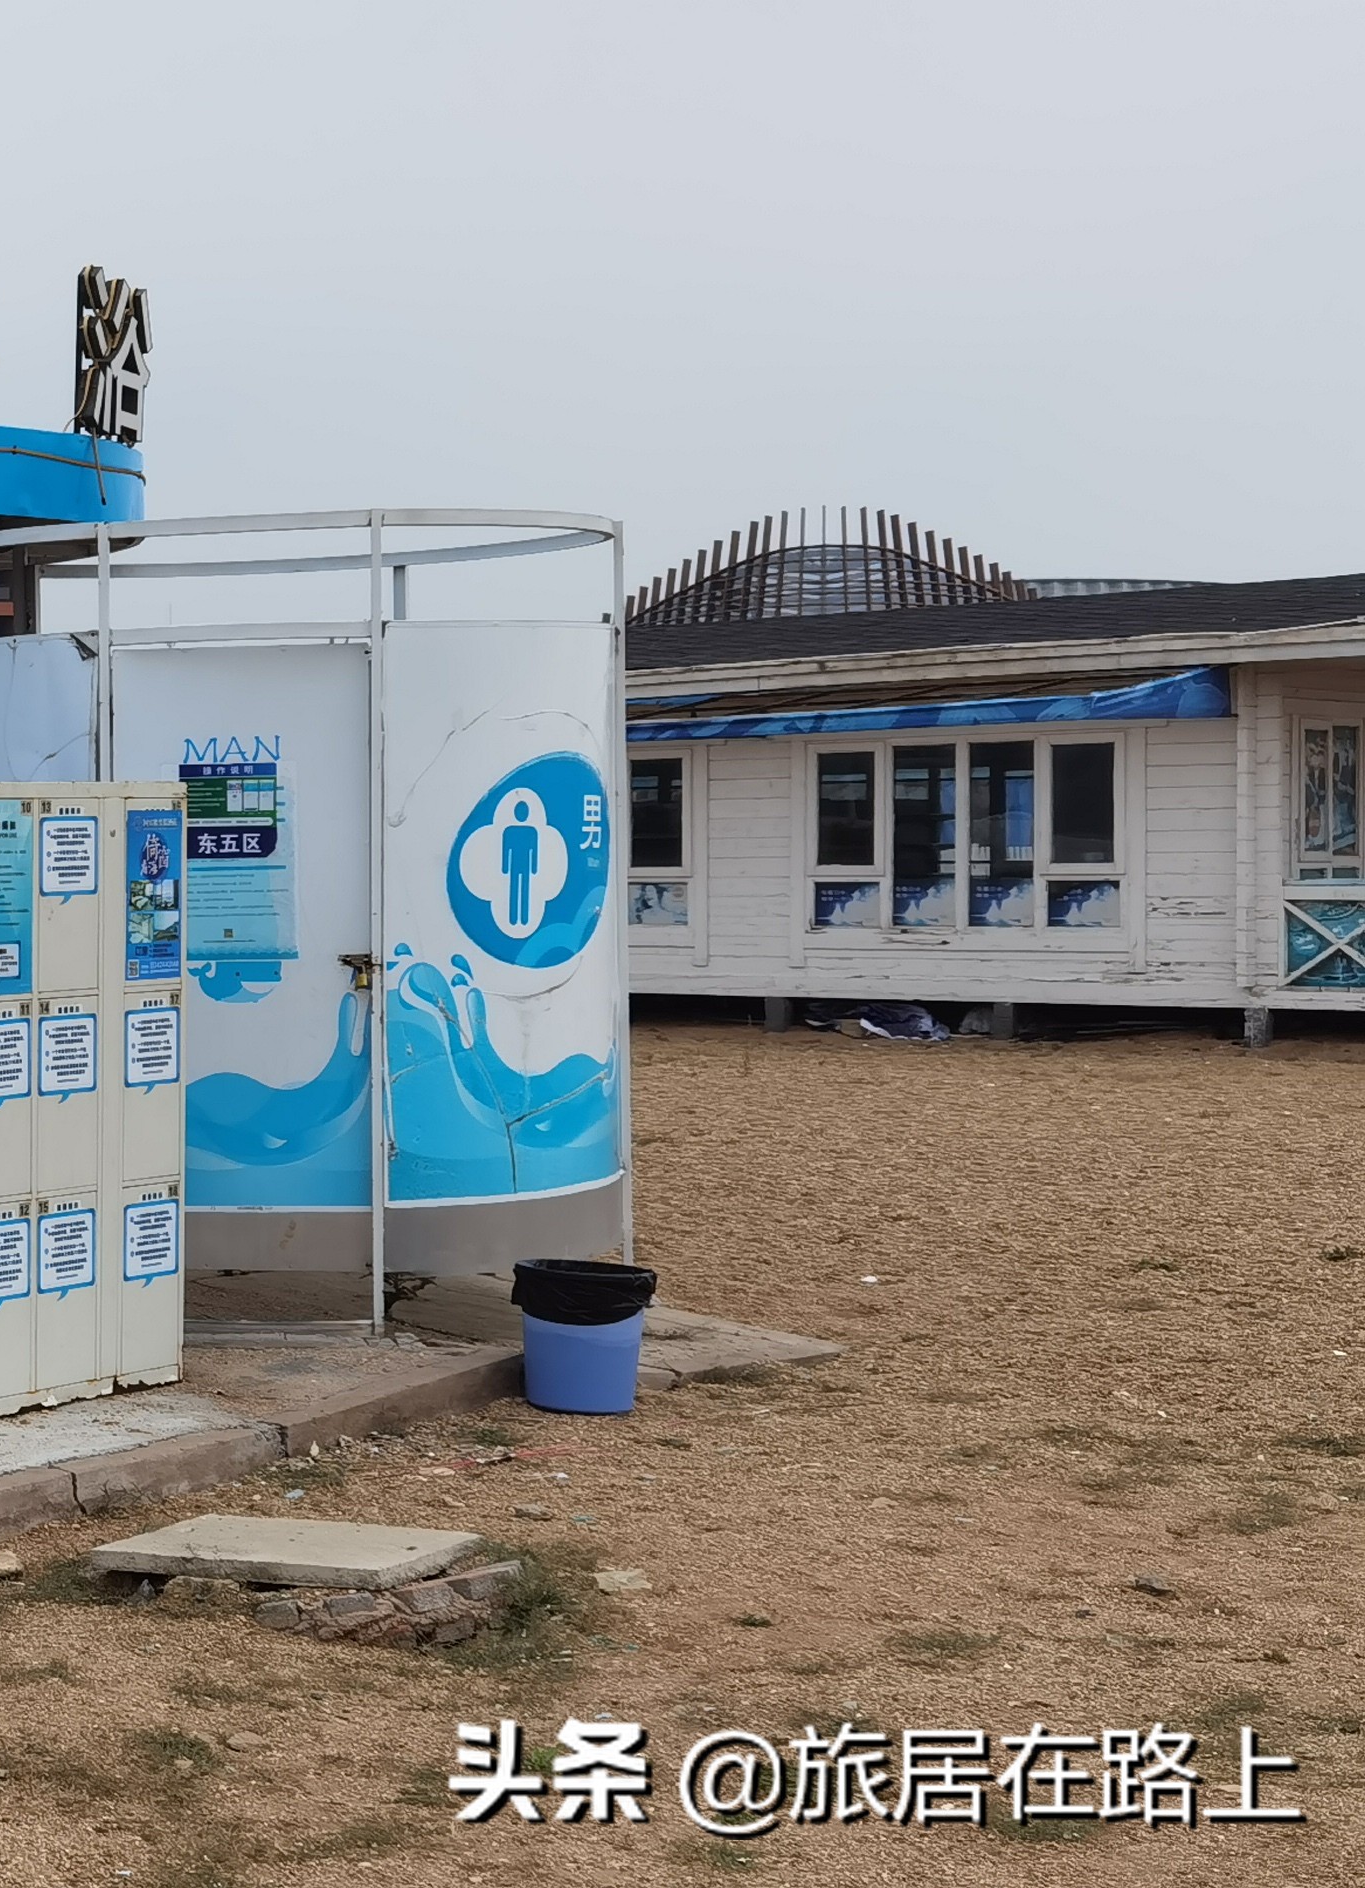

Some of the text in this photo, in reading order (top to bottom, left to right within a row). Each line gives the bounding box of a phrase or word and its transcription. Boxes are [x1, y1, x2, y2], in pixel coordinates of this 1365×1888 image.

[183, 735, 280, 763] MAN
[21, 803, 31, 813] 10
[41, 802, 51, 812] 13
[579, 795, 602, 850] 男
[197, 833, 262, 854] 东五区
[39, 1002, 50, 1013] 14
[19, 1205, 29, 1216] 12
[39, 1202, 49, 1213] 15
